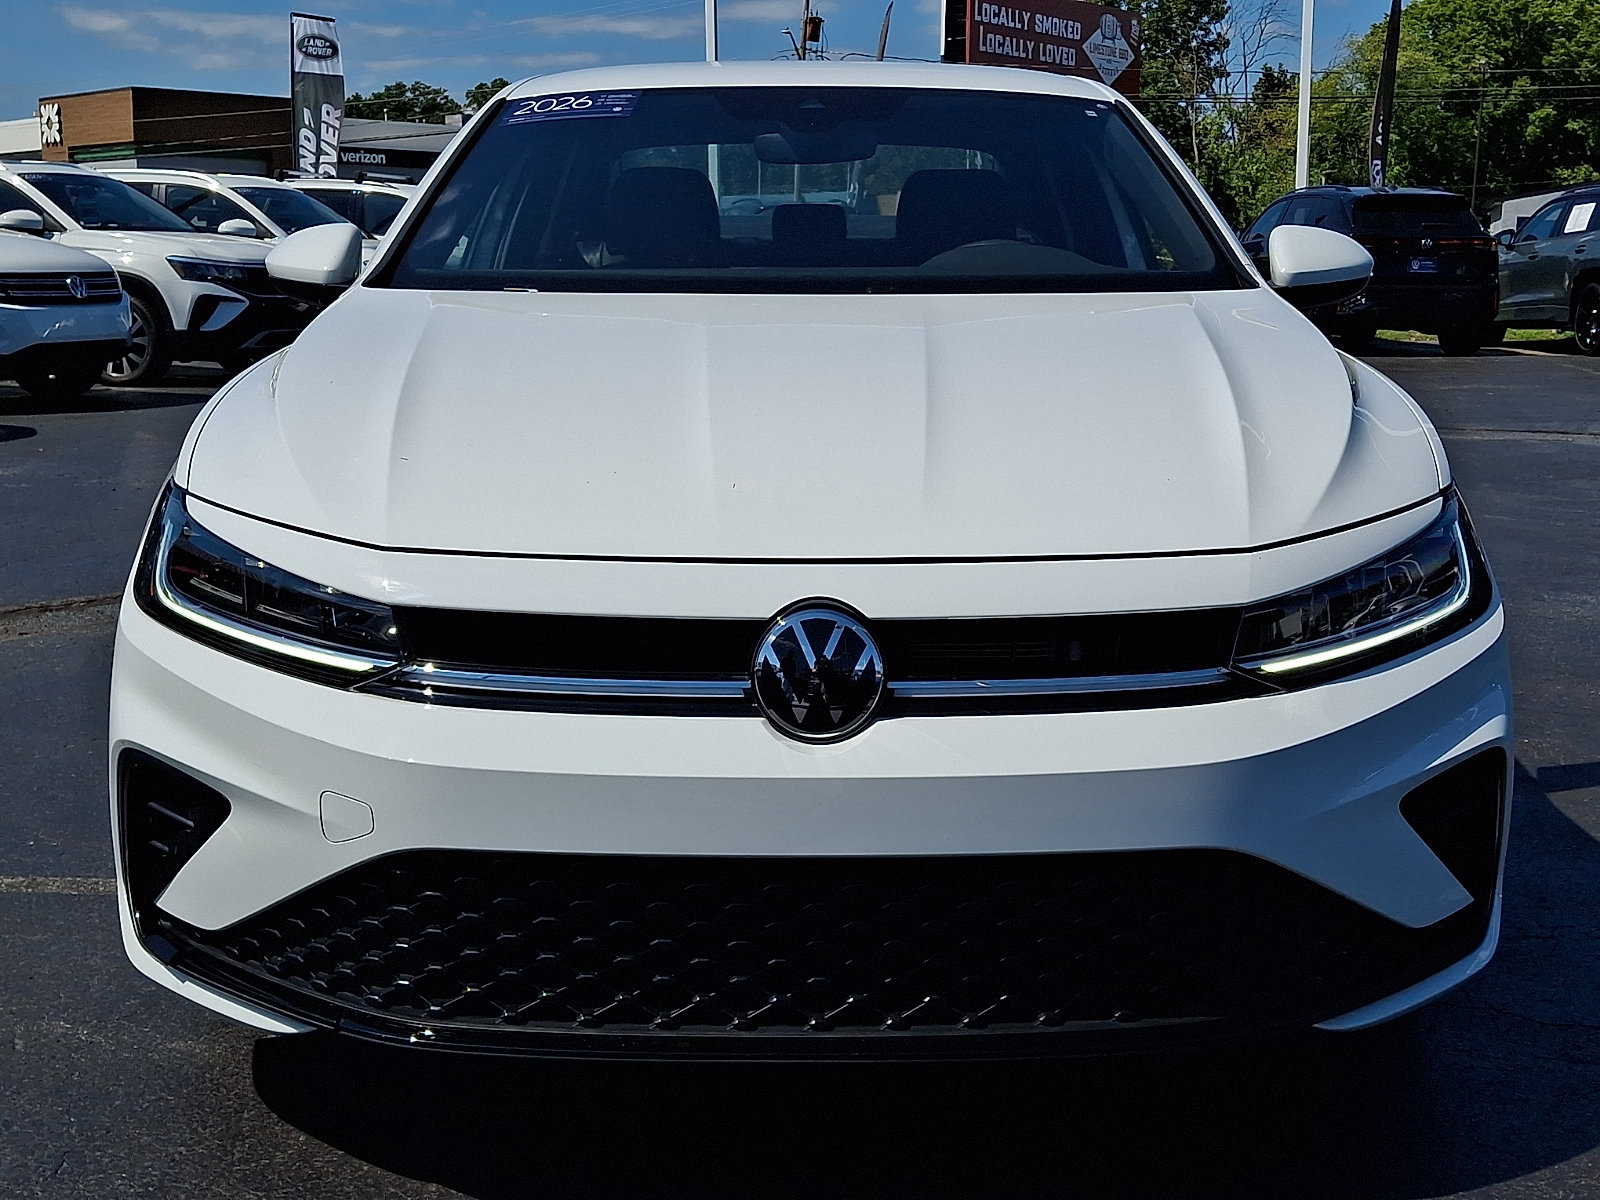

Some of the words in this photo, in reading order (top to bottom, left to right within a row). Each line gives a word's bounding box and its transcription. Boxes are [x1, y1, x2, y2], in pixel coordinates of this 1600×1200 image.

[974, 0, 1030, 30] LOCALLY
[1034, 13, 1082, 40] SMOKED
[304, 38, 325, 47] LAND
[306, 46, 333, 56] ROVER
[979, 25, 1034, 59] LOCALLY
[1039, 42, 1076, 67] LOVED
[513, 95, 593, 116] 2026
[340, 150, 386, 164] verizon
